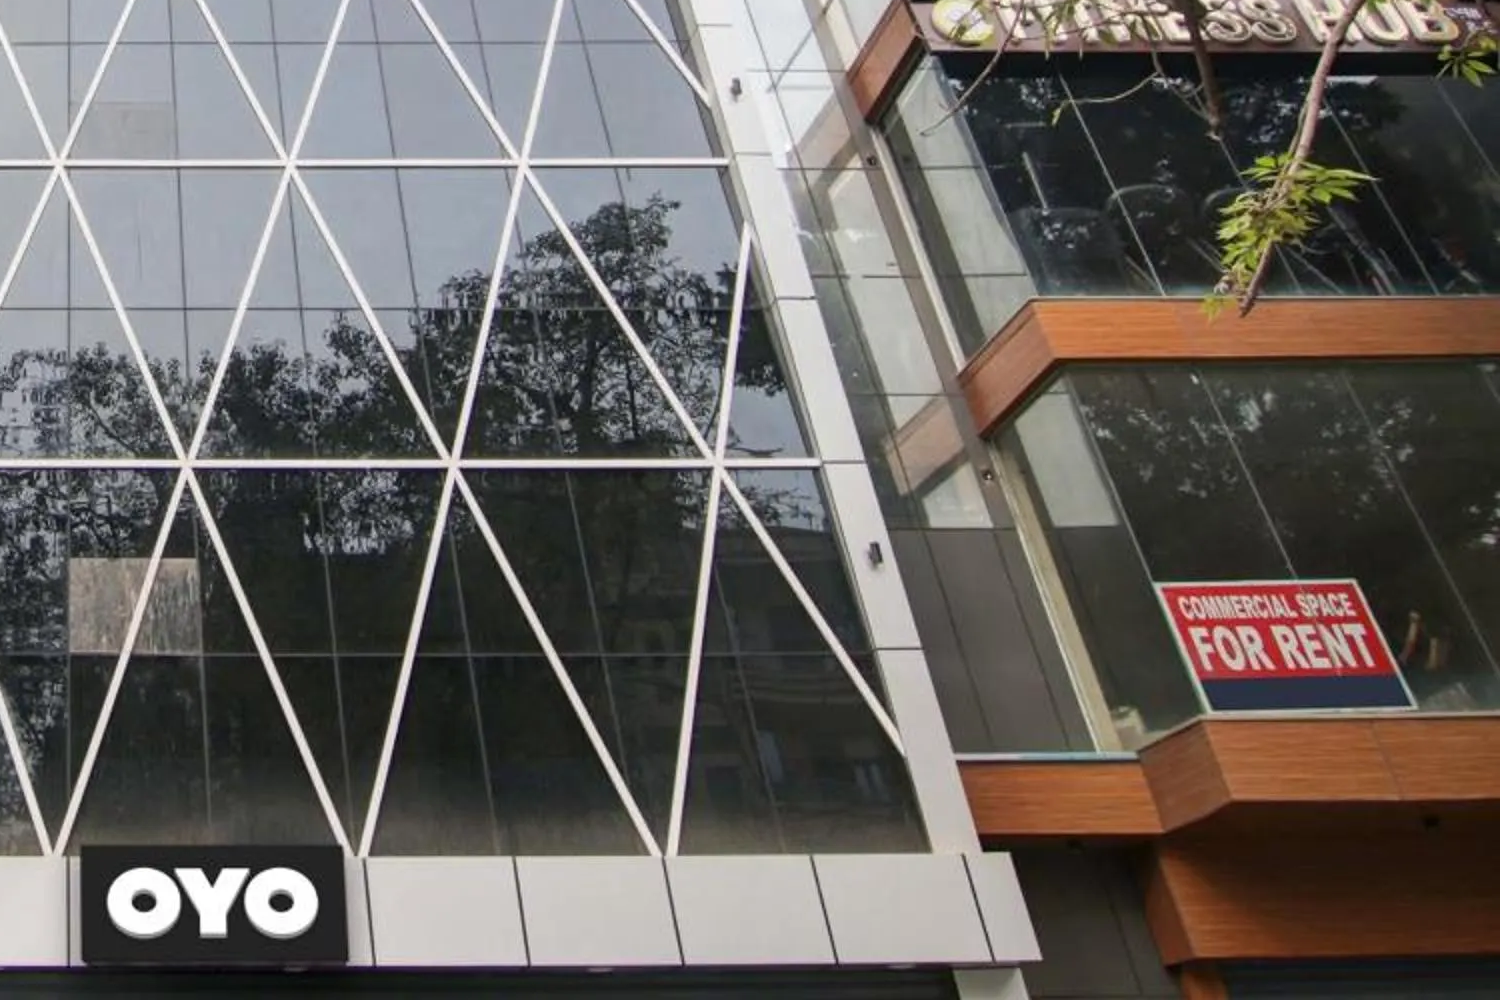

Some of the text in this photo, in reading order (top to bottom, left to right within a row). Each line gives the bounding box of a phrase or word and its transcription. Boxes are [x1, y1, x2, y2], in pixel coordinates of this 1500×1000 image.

[1177, 593, 1357, 620] COMMERCIAL SPACE
[1188, 623, 1376, 671] FOR RENT
[107, 867, 319, 939] OYO
